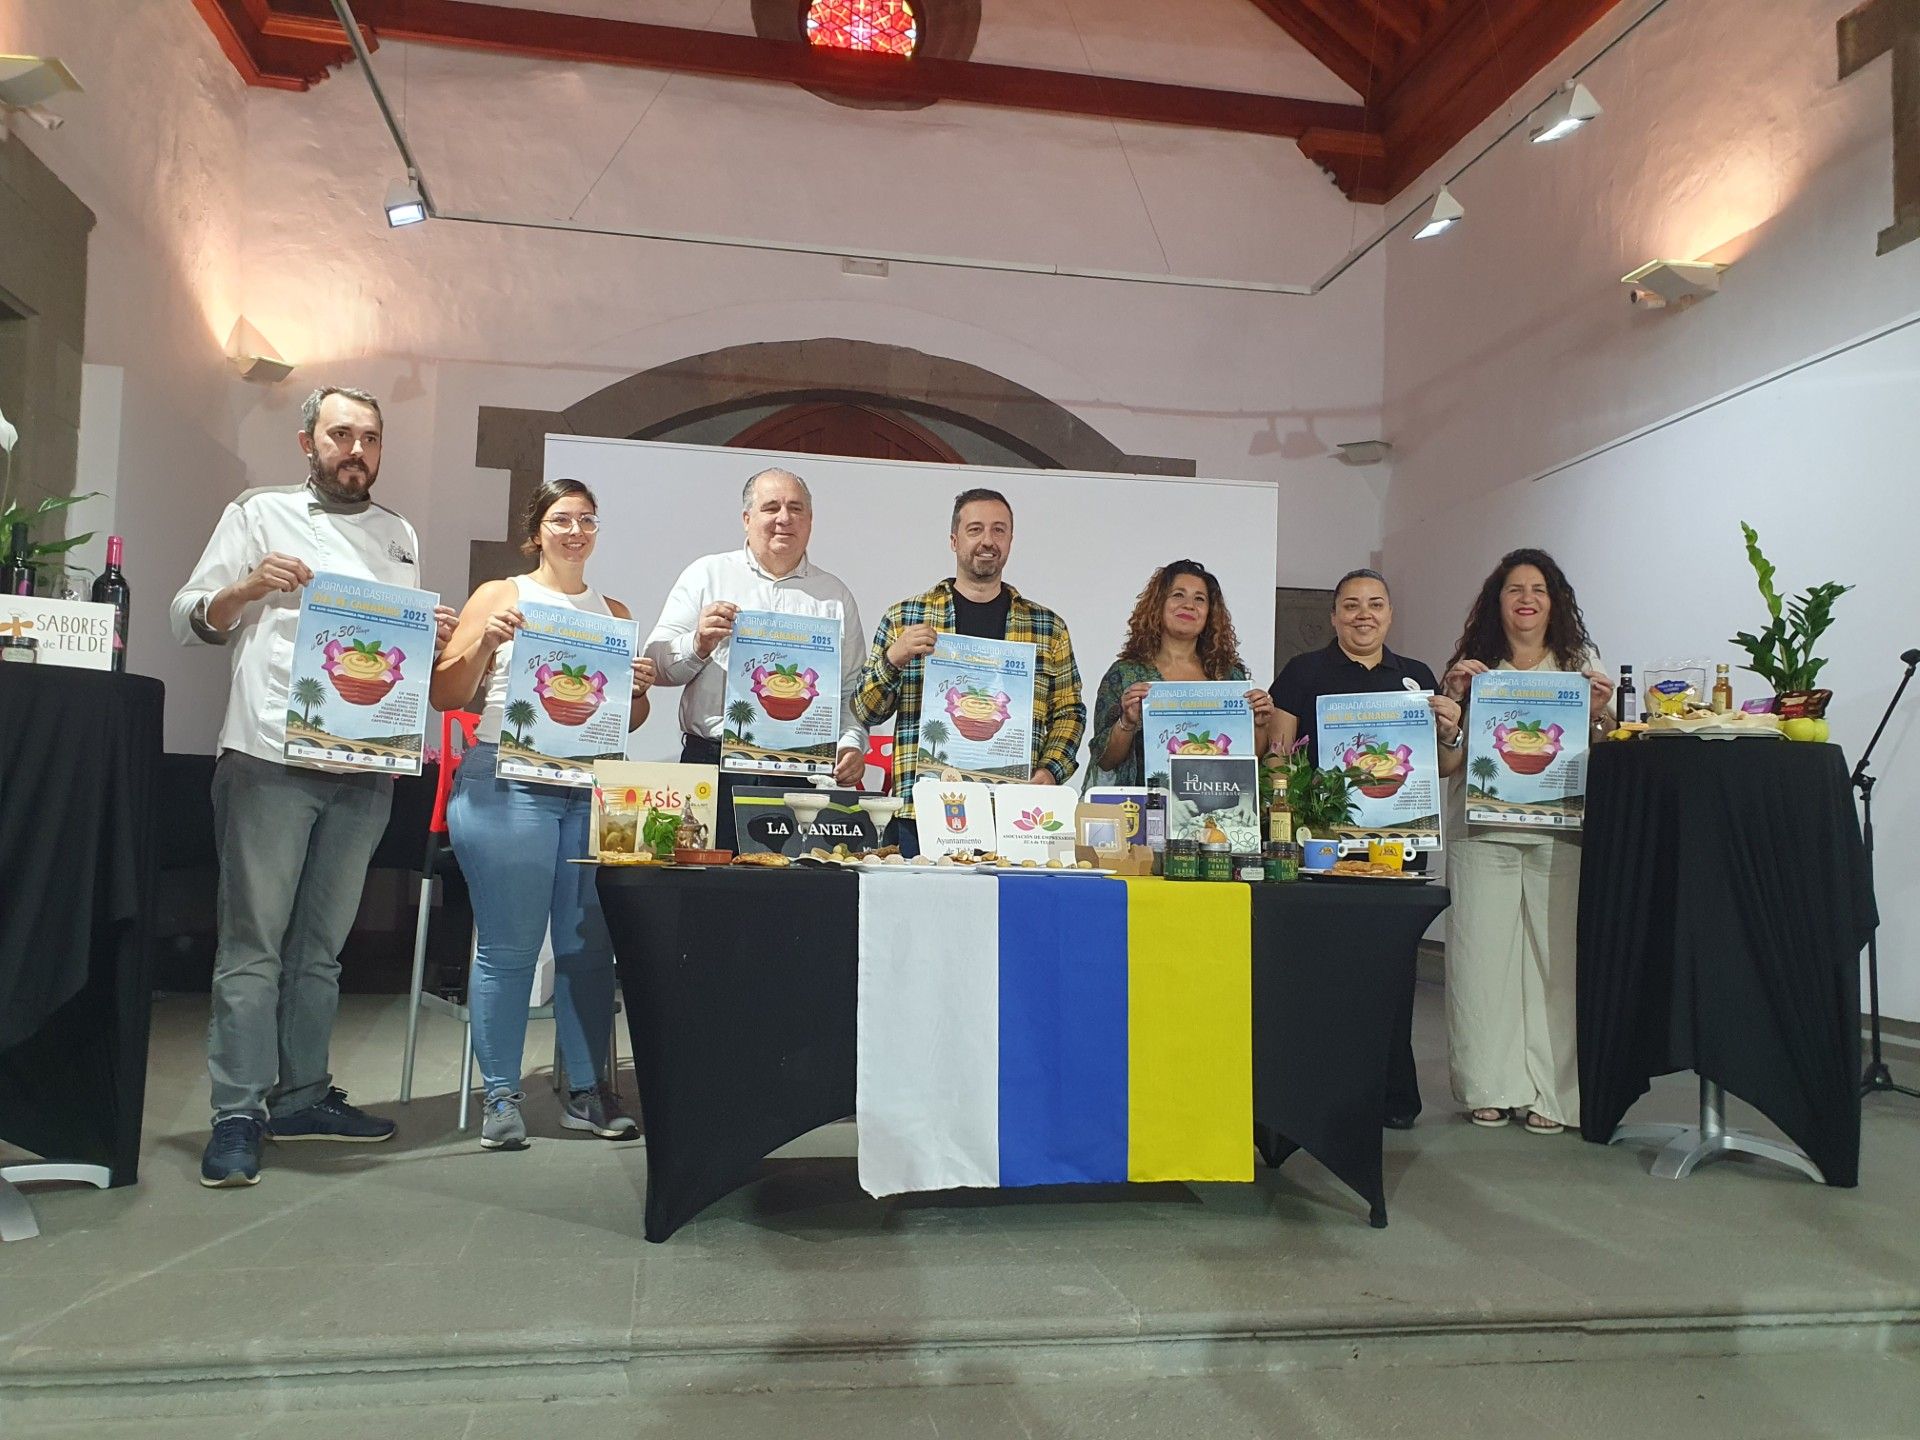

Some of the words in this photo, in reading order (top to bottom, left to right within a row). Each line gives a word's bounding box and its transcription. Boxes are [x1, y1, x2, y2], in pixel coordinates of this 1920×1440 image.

[318, 582, 360, 597] JORNADA
[402, 609, 427, 622] 2025
[527, 609, 568, 624] JORNADA
[36, 614, 108, 636] SABORES
[316, 630, 330, 646] 27
[339, 625, 356, 638] 30
[812, 635, 831, 646] 2025
[42, 640, 56, 649] de
[56, 634, 107, 654] TELDE
[605, 636, 627, 648] 2025
[528, 655, 541, 669] 27
[548, 650, 564, 662] 30
[744, 658, 756, 672] 27
[762, 652, 776, 665] 30
[1005, 660, 1026, 670] 2025
[938, 680, 949, 692] 27
[1558, 690, 1580, 700] 2025
[1224, 700, 1244, 708] 2025
[1403, 710, 1424, 718] 2025
[1486, 717, 1496, 730] 27
[1504, 710, 1518, 720] 30
[1158, 729, 1169, 744] 27
[1174, 722, 1188, 734] 30
[1334, 742, 1345, 756] 27
[1186, 771, 1199, 782] La
[1183, 781, 1240, 792] TUNERA
[766, 822, 790, 834] LA
[936, 836, 982, 846] Ayuntamiento
